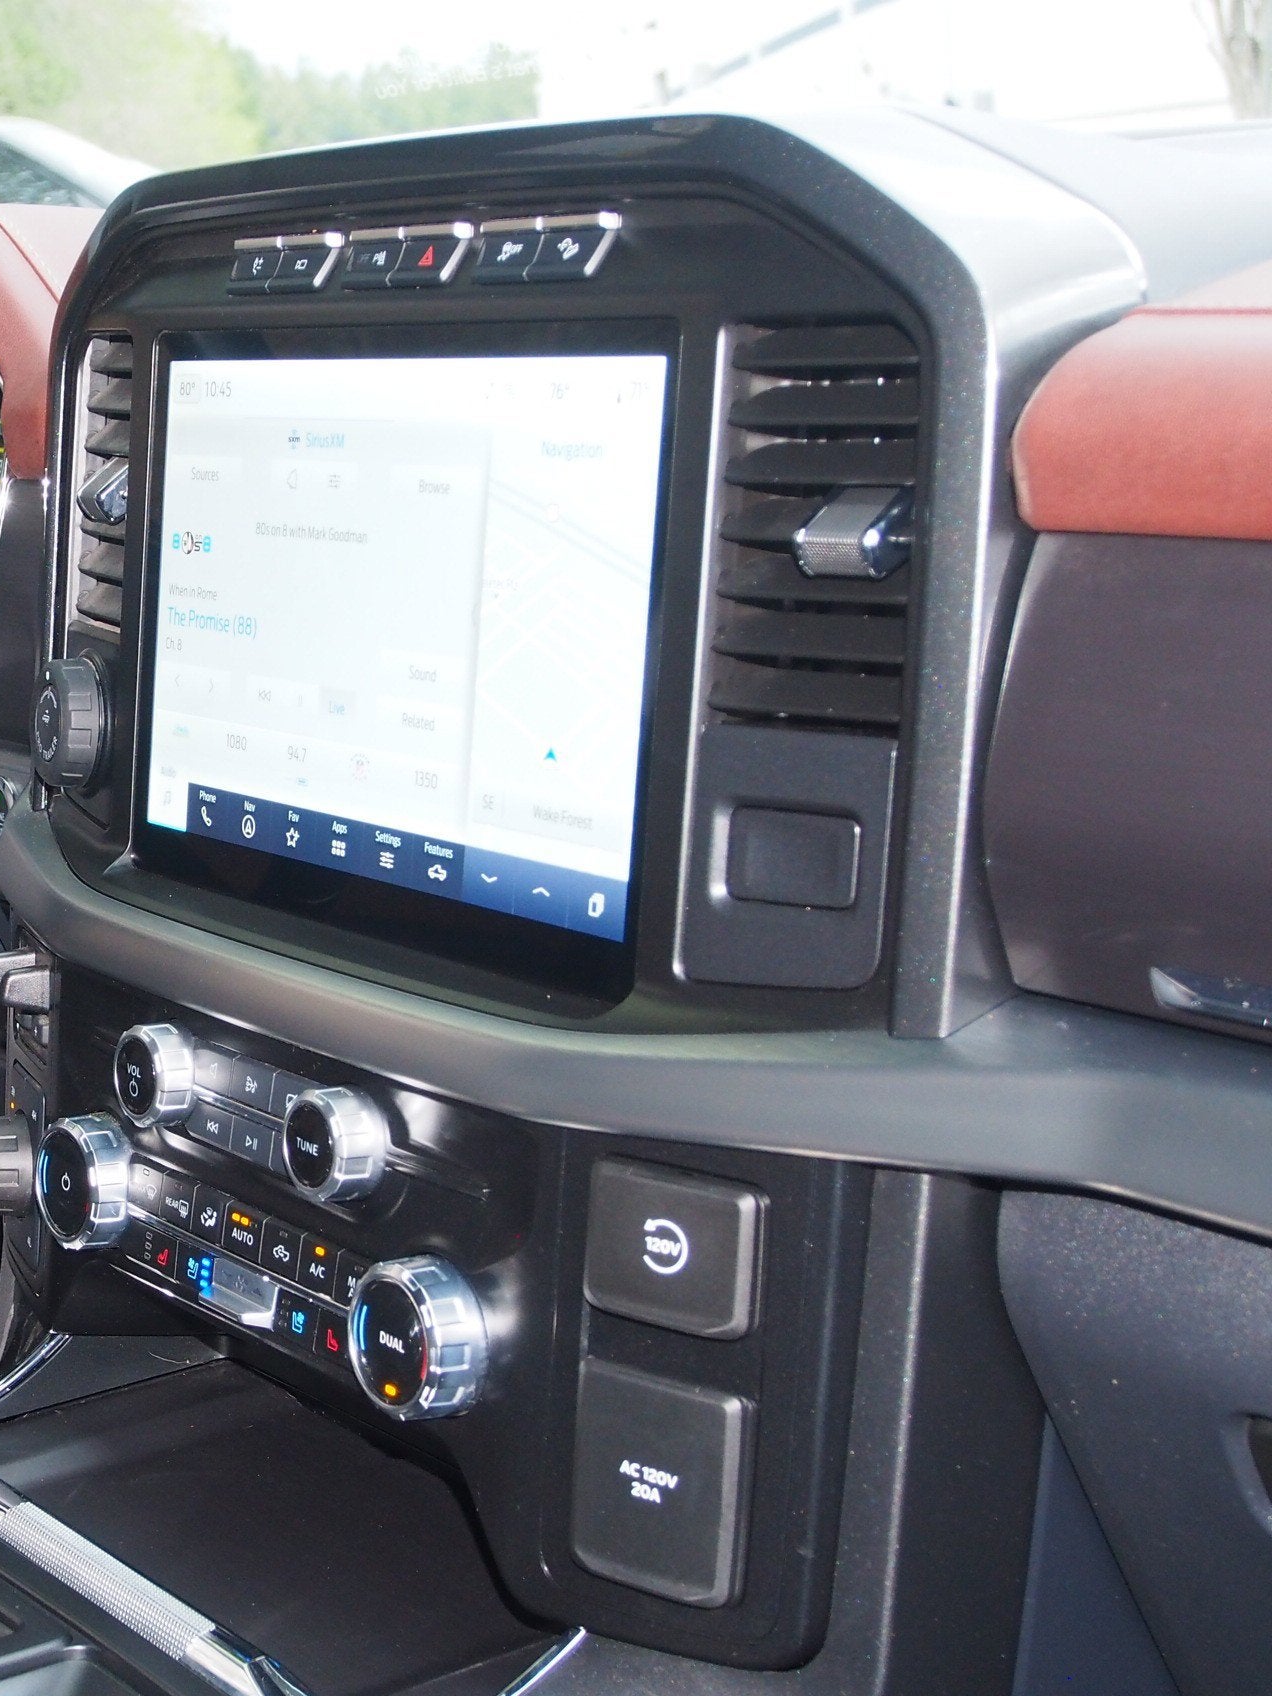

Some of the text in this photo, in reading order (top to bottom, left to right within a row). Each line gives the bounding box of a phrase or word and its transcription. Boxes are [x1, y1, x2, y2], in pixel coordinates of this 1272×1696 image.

[205, 381, 232, 397] 10:45
[541, 440, 604, 461] Navigation
[191, 466, 219, 482] Sources
[418, 478, 451, 495] Browse
[197, 586, 218, 601] Rome
[168, 606, 258, 640] The Promise (88)
[408, 664, 438, 683] Sound
[401, 712, 436, 732] Related
[226, 732, 248, 751] 1080
[287, 744, 308, 763] 94.7
[414, 770, 438, 790] 1350
[199, 789, 217, 805] Phone
[243, 800, 256, 813] Nav
[288, 810, 300, 824] Fav
[532, 804, 594, 831] Wake Forest
[331, 820, 348, 835] Apps
[375, 830, 402, 848] Settings
[424, 841, 454, 859] Features
[126, 1062, 141, 1079] VOL
[296, 1136, 319, 1157] TUNE
[231, 1227, 254, 1246] AUTO
[644, 1236, 682, 1257] 120V
[309, 1262, 326, 1279] A/C
[379, 1330, 405, 1354] DUAL
[619, 1459, 678, 1489] AC 120V
[630, 1481, 661, 1504] 20A
